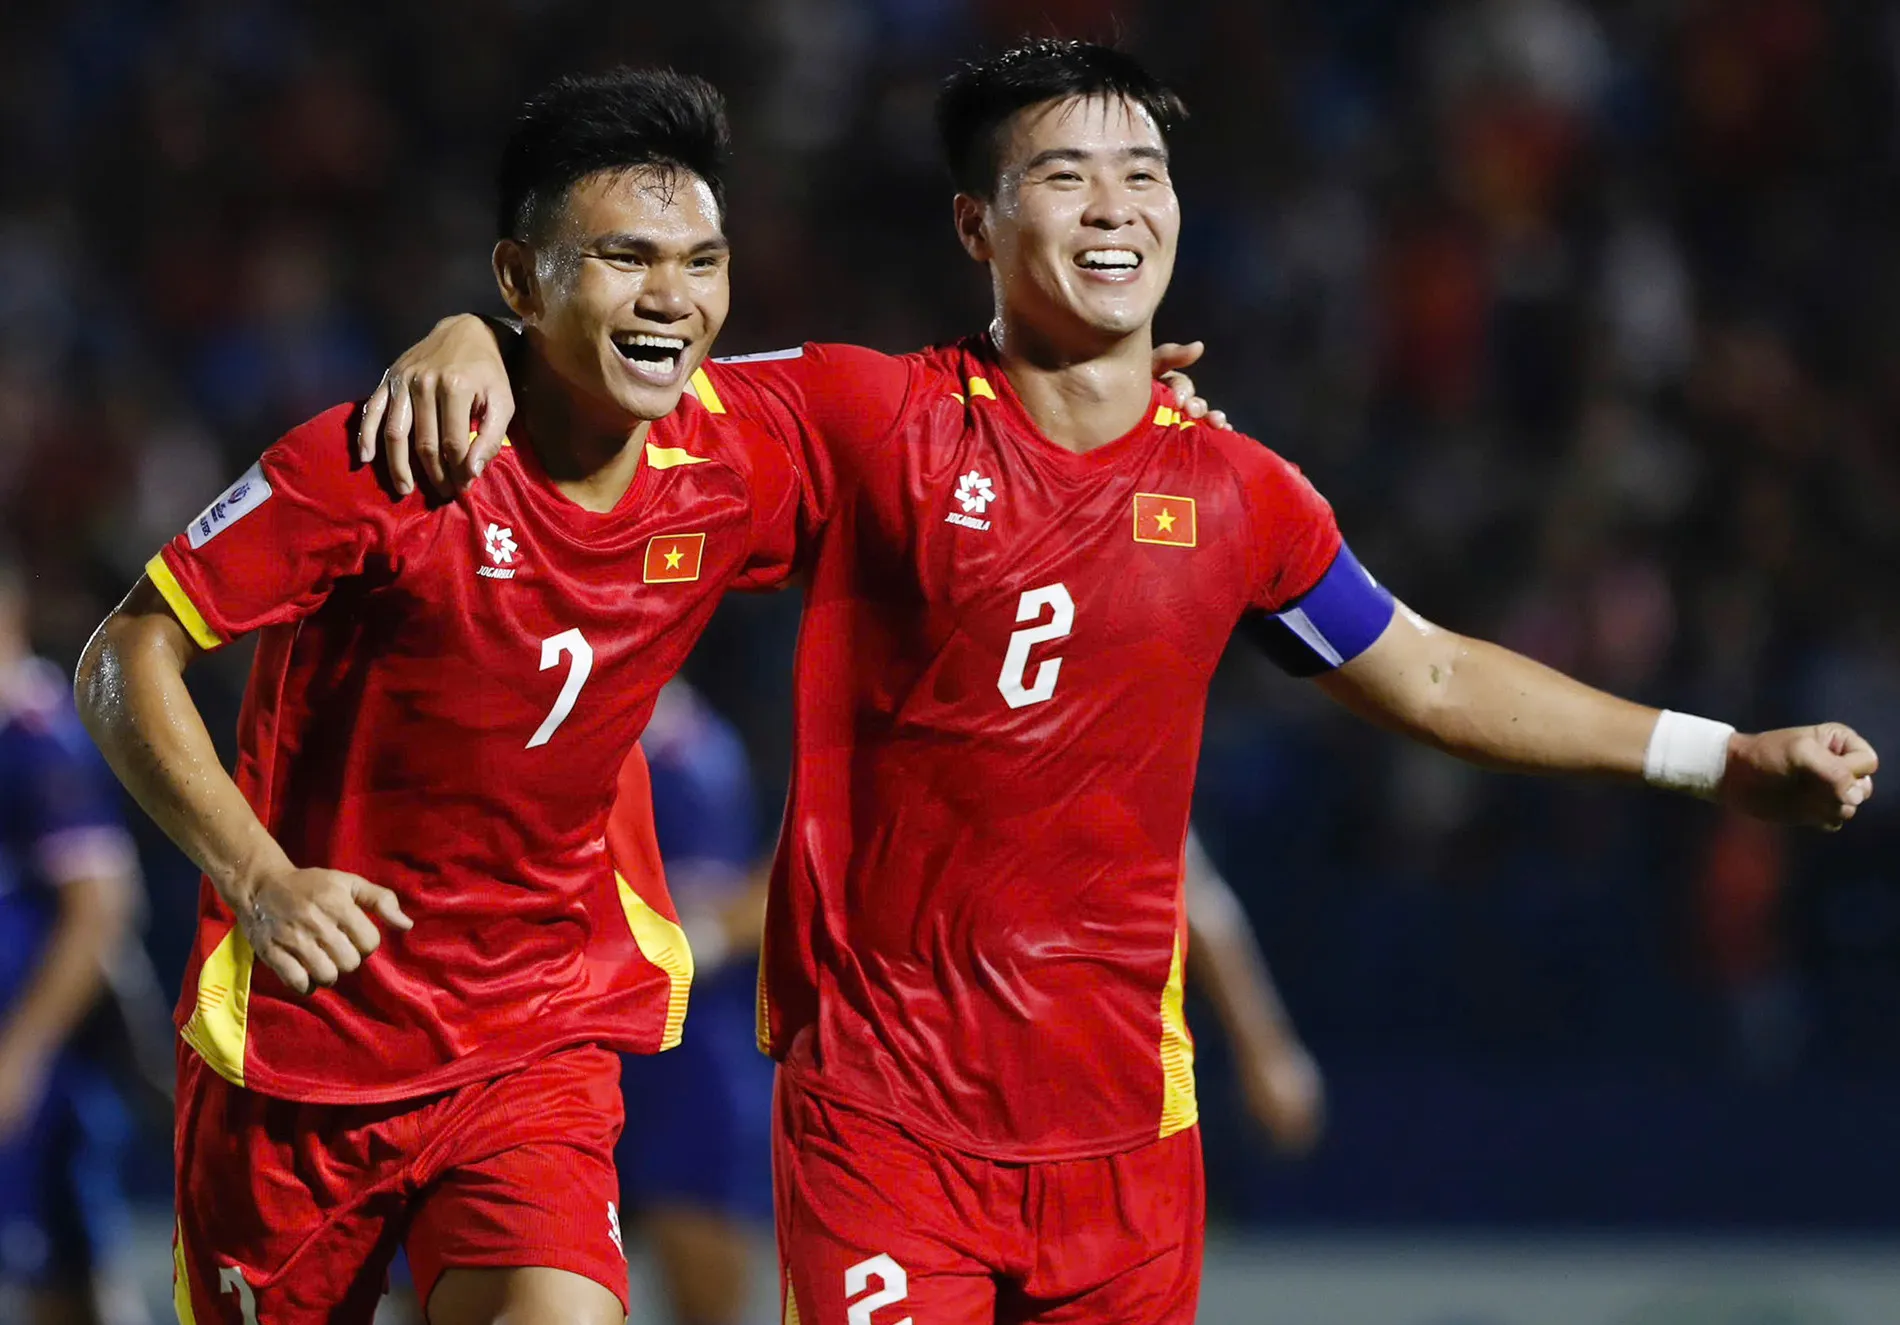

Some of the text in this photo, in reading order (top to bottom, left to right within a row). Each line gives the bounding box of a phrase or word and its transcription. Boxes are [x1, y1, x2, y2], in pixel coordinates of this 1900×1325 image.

[524, 627, 594, 749] 7
[997, 582, 1076, 710] 2
[844, 1252, 913, 1325] 2
